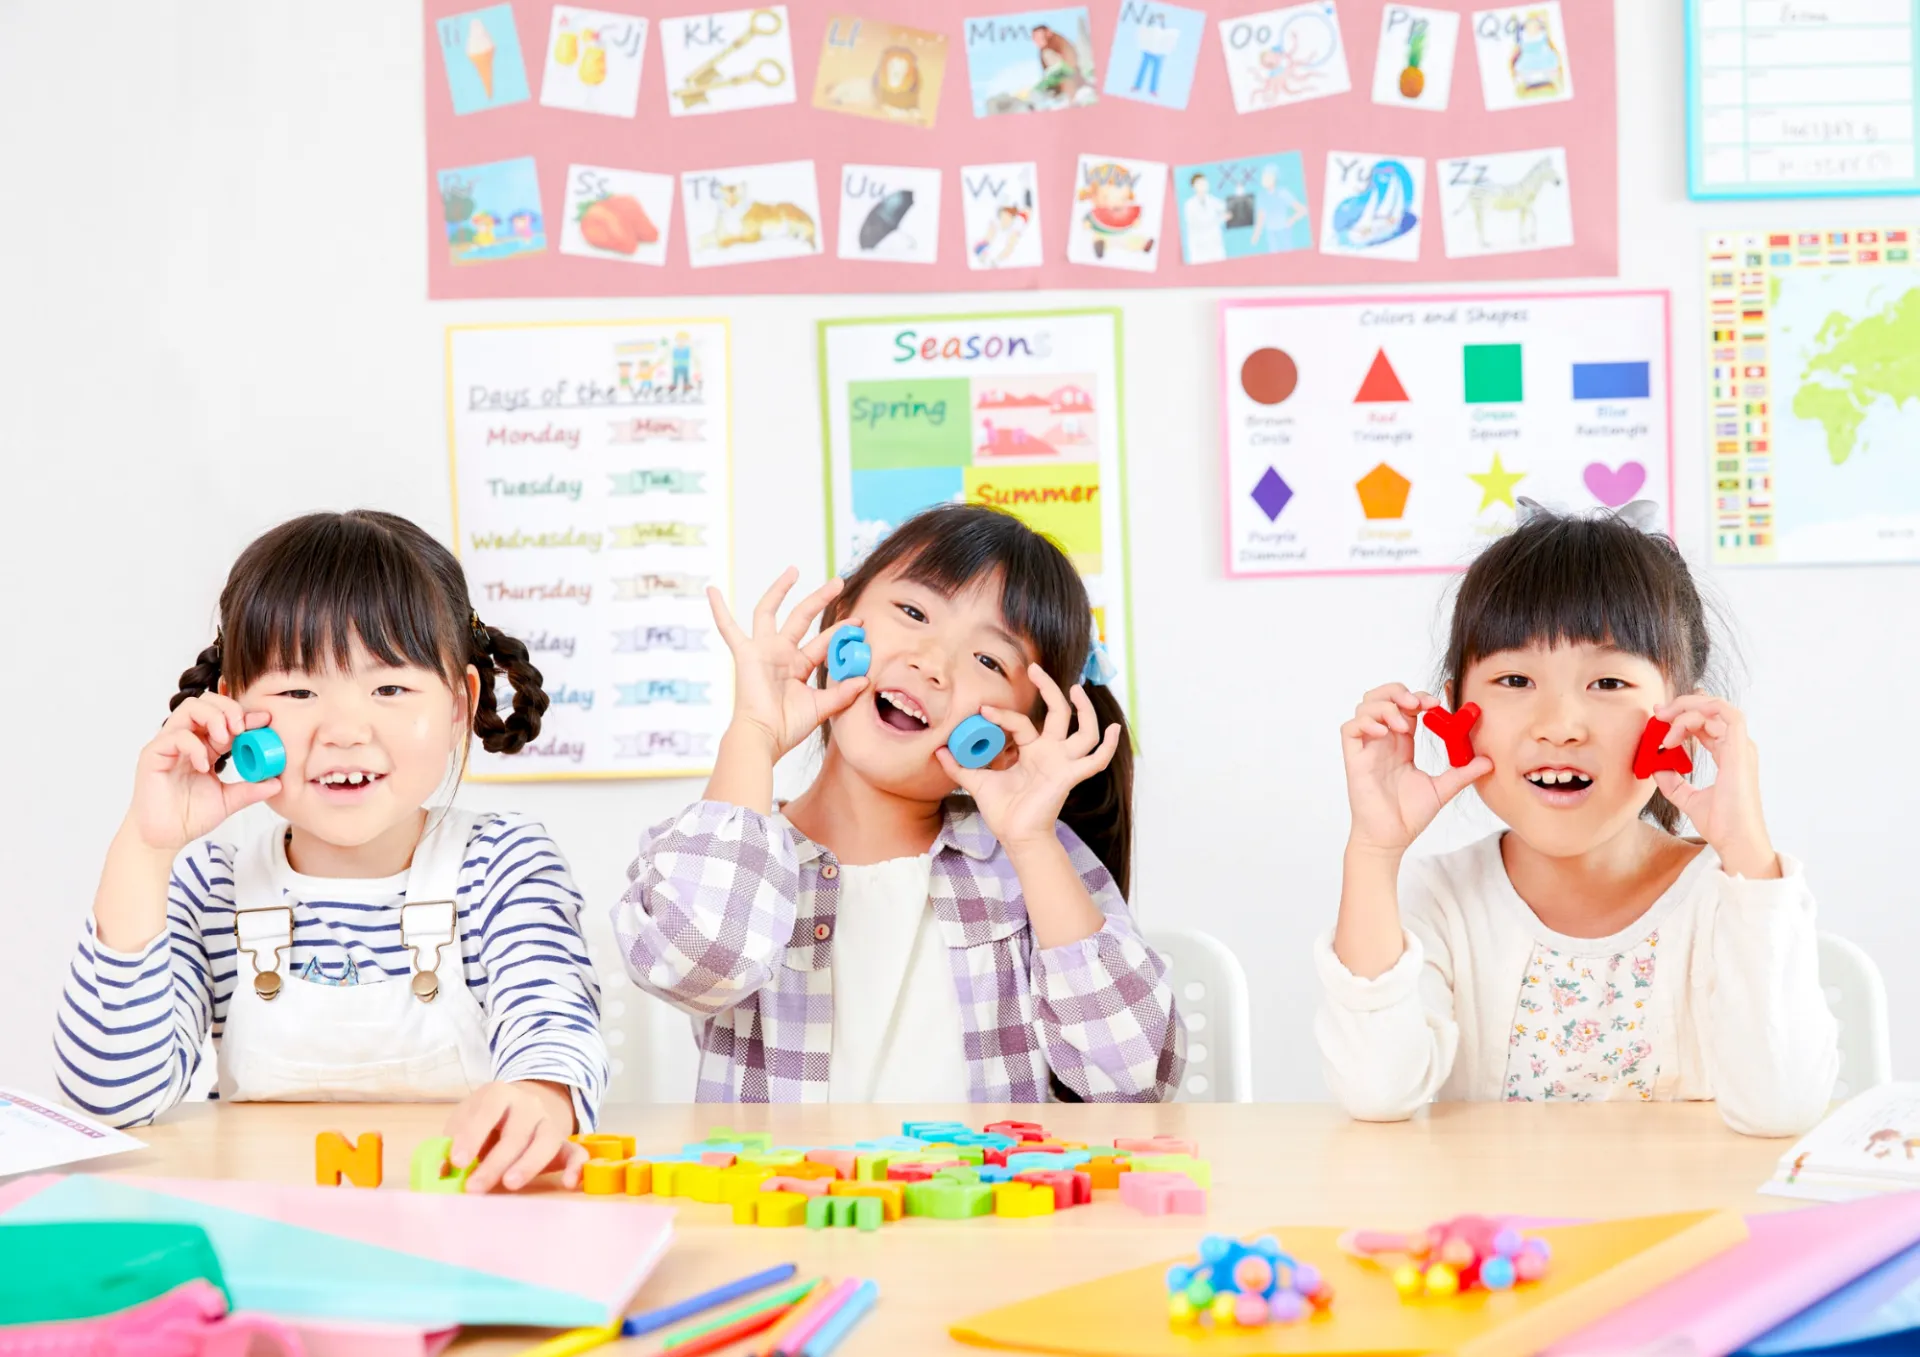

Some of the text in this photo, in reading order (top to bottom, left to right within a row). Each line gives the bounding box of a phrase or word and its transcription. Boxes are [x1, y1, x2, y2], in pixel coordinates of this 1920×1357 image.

[1121, 1, 1167, 27] Nn
[1386, 9, 1429, 44] Pp
[684, 16, 726, 48] Kk
[968, 20, 1033, 45] Mm
[1229, 23, 1272, 49] Oo
[575, 171, 610, 198] Ss
[843, 175, 888, 199] Uu
[1449, 161, 1491, 187] Zz
[684, 176, 722, 201] Tt
[1359, 307, 1528, 327] Colors and Shapes
[893, 330, 1052, 363] Seasons
[468, 384, 531, 412] Days
[541, 380, 568, 406] of
[576, 380, 617, 403] the
[852, 393, 947, 429] Spring
[486, 420, 581, 450] Monday
[487, 473, 583, 502] Tuesday
[976, 483, 1100, 506] Summer
[470, 526, 603, 553] Wednesday
[484, 576, 592, 605] Thursday
